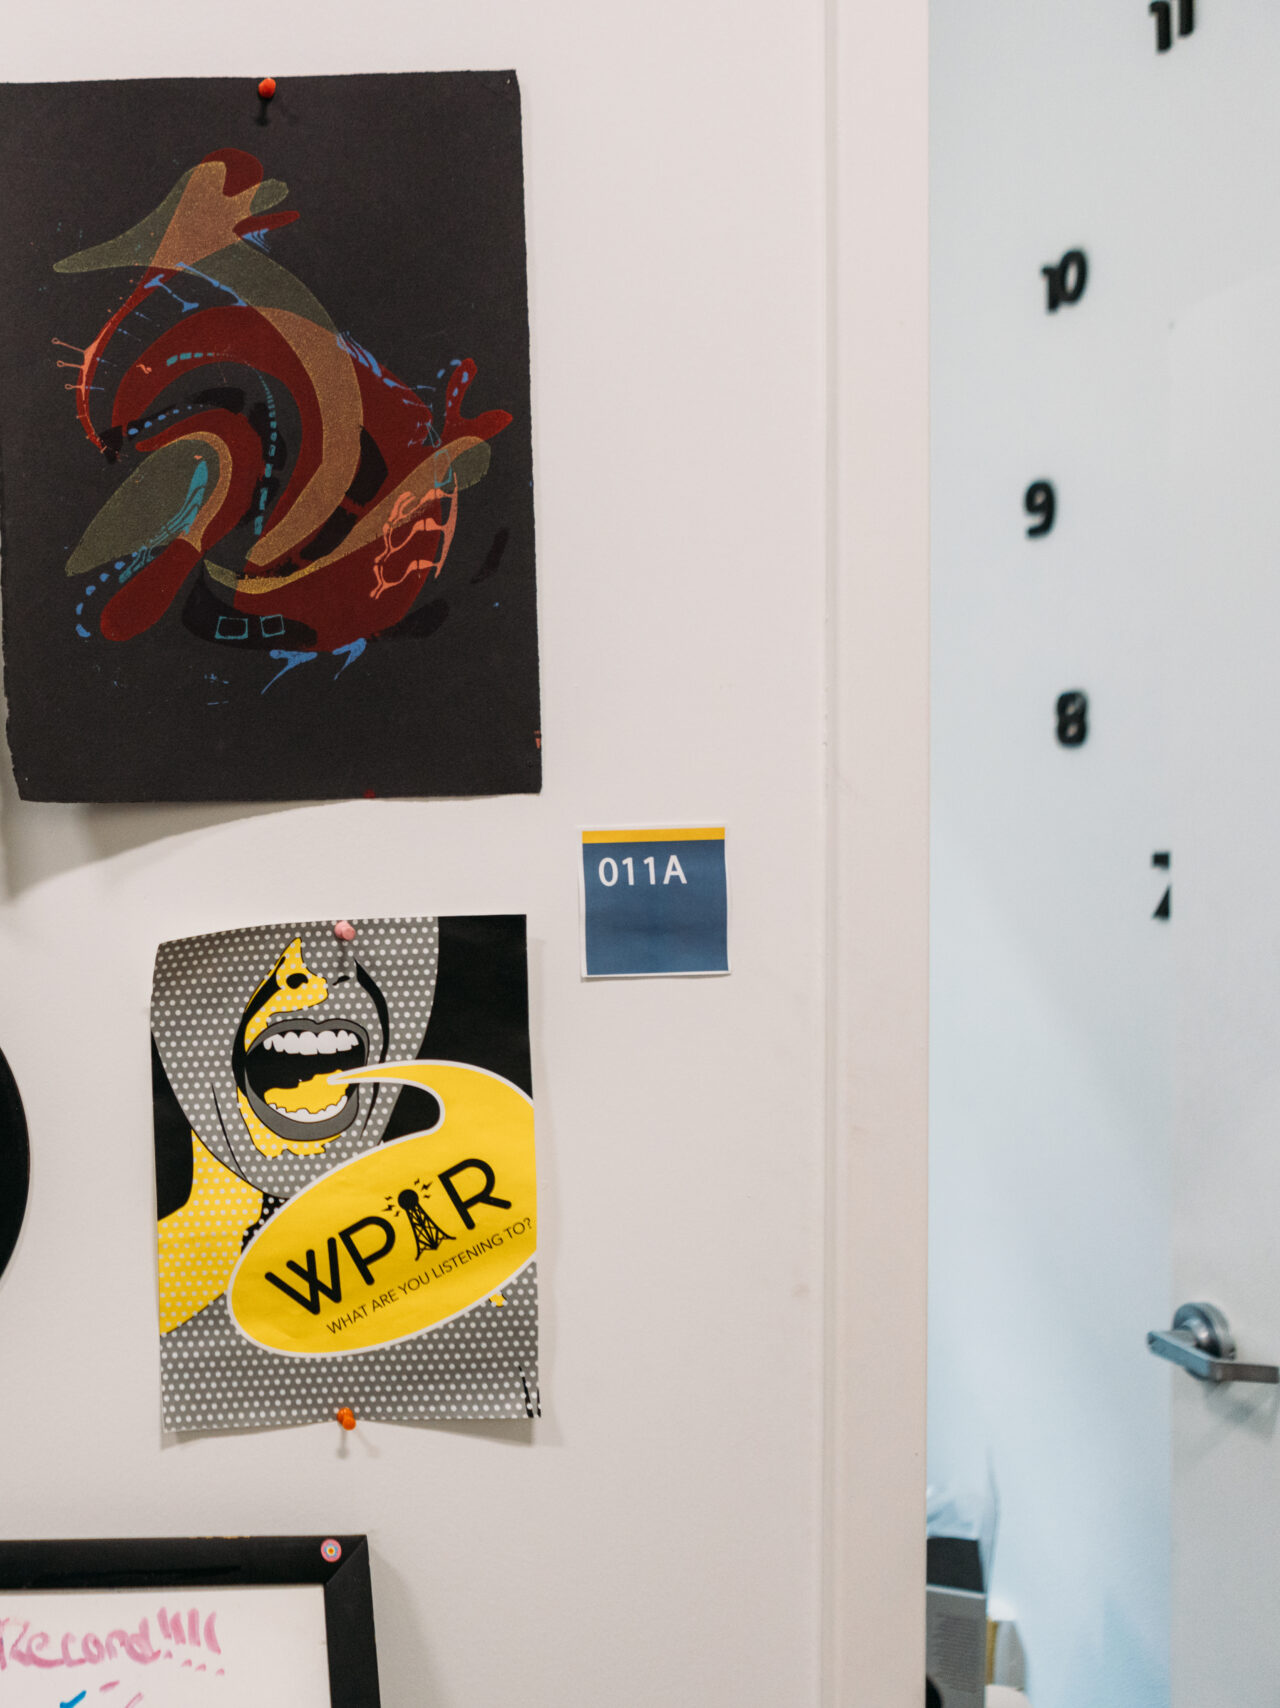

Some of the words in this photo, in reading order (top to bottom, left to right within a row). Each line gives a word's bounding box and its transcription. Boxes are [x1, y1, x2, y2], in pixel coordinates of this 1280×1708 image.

[1041, 249, 1088, 312] 10
[1023, 479, 1057, 539] 9
[1054, 690, 1090, 750] 8
[597, 854, 688, 888] 011A
[326, 1304, 368, 1335] WHAT
[371, 1288, 399, 1313] ARE
[397, 1271, 431, 1295] YOU
[433, 1232, 504, 1279] LISTENING
[505, 1217, 532, 1240] TO?
